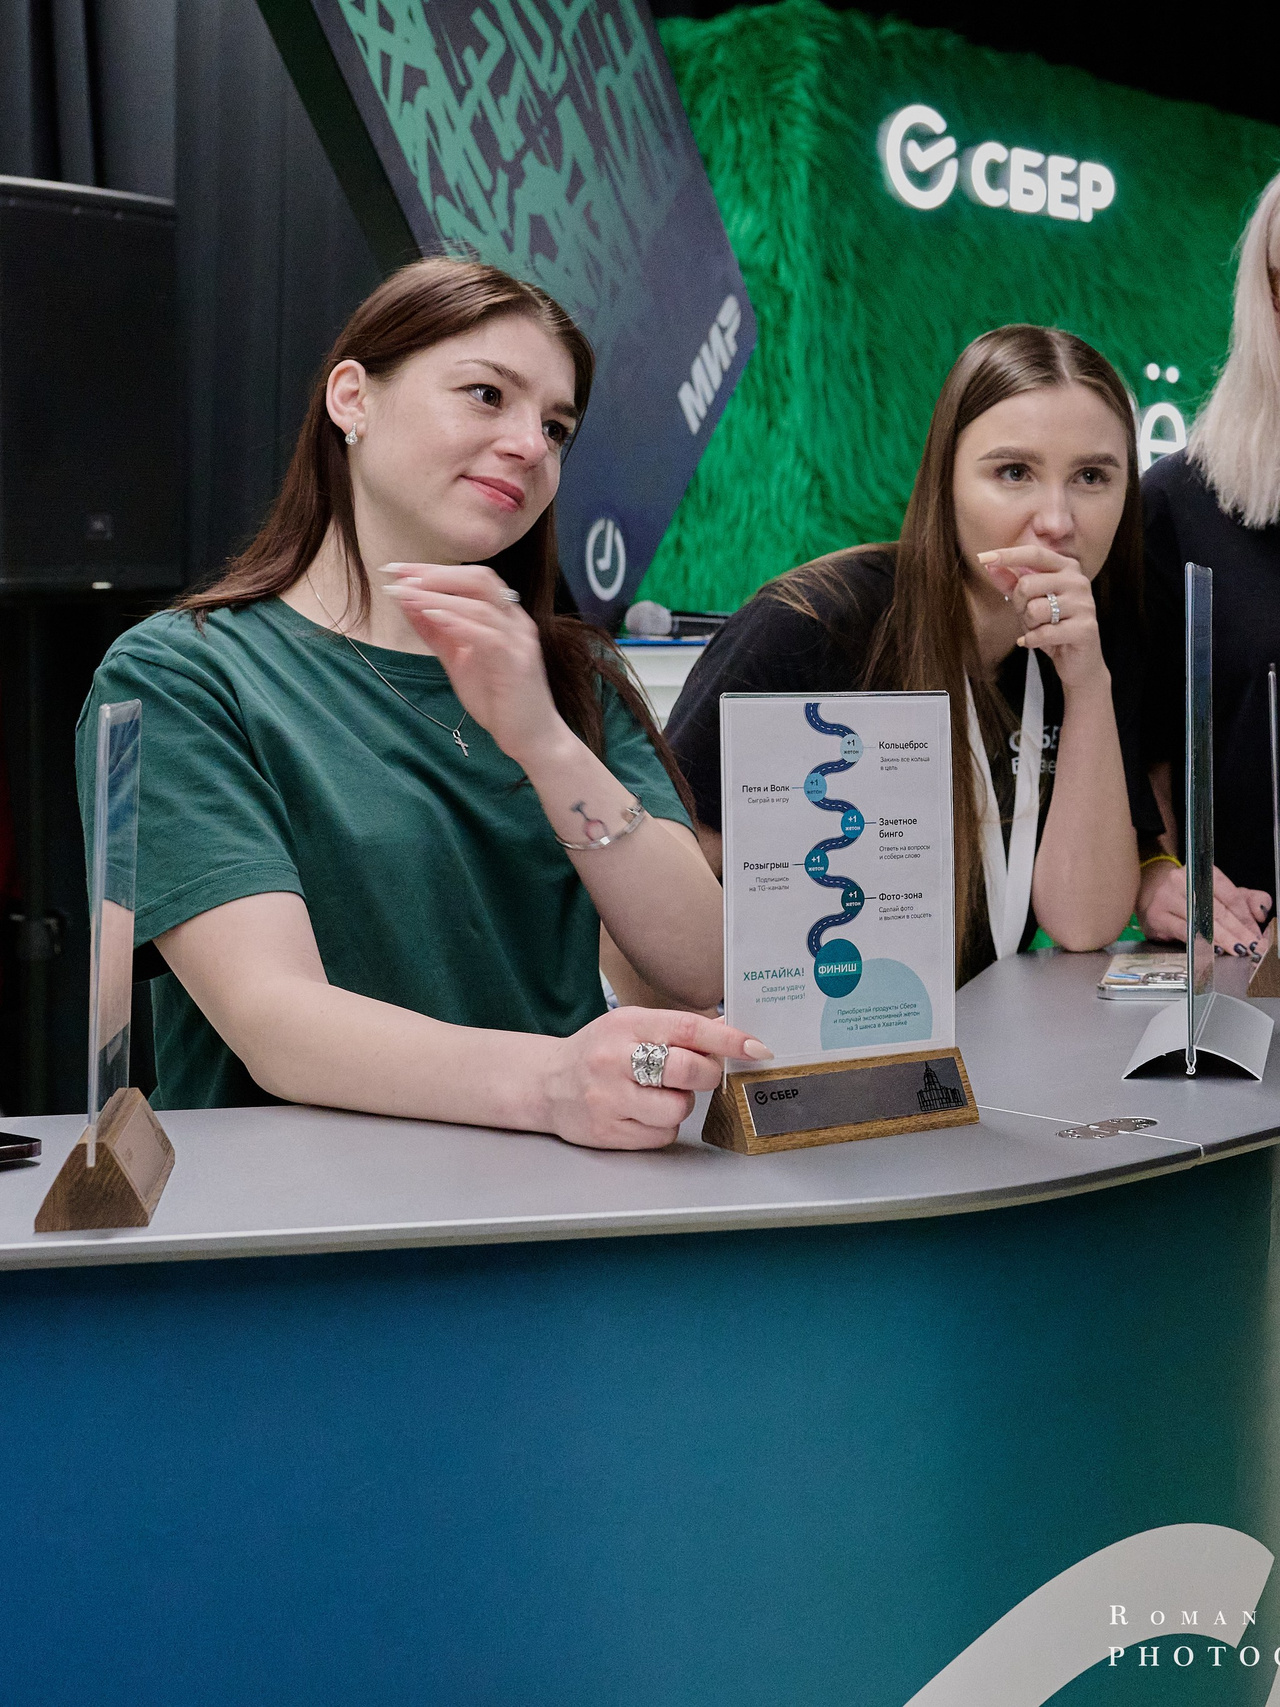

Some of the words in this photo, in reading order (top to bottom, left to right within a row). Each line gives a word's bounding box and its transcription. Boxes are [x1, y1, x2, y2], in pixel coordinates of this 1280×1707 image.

[971, 141, 1116, 222] СБЕР
[677, 296, 741, 434] МИР
[878, 740, 928, 750] Кольцеброс
[742, 785, 761, 793] Петя
[770, 784, 790, 792] Волк
[879, 817, 917, 826] Зачетное
[879, 829, 904, 838] бинго
[811, 855, 820, 863] +1
[743, 861, 789, 871] Розыгрыш
[849, 890, 857, 899] +1
[878, 892, 923, 901] Фото-зона
[879, 905, 899, 913] Сделай
[743, 967, 805, 981] ХВАТАЙКА!
[818, 963, 857, 975] ФИНИШ
[762, 985, 785, 993] Схвати
[786, 984, 805, 992] удачу
[762, 995, 786, 1004] получи
[787, 993, 805, 1001] приз!
[837, 1006, 871, 1016] Приобретай
[872, 1005, 898, 1013] продукты
[900, 1002, 916, 1010] Сбера
[770, 1089, 799, 1101] СБЕР
